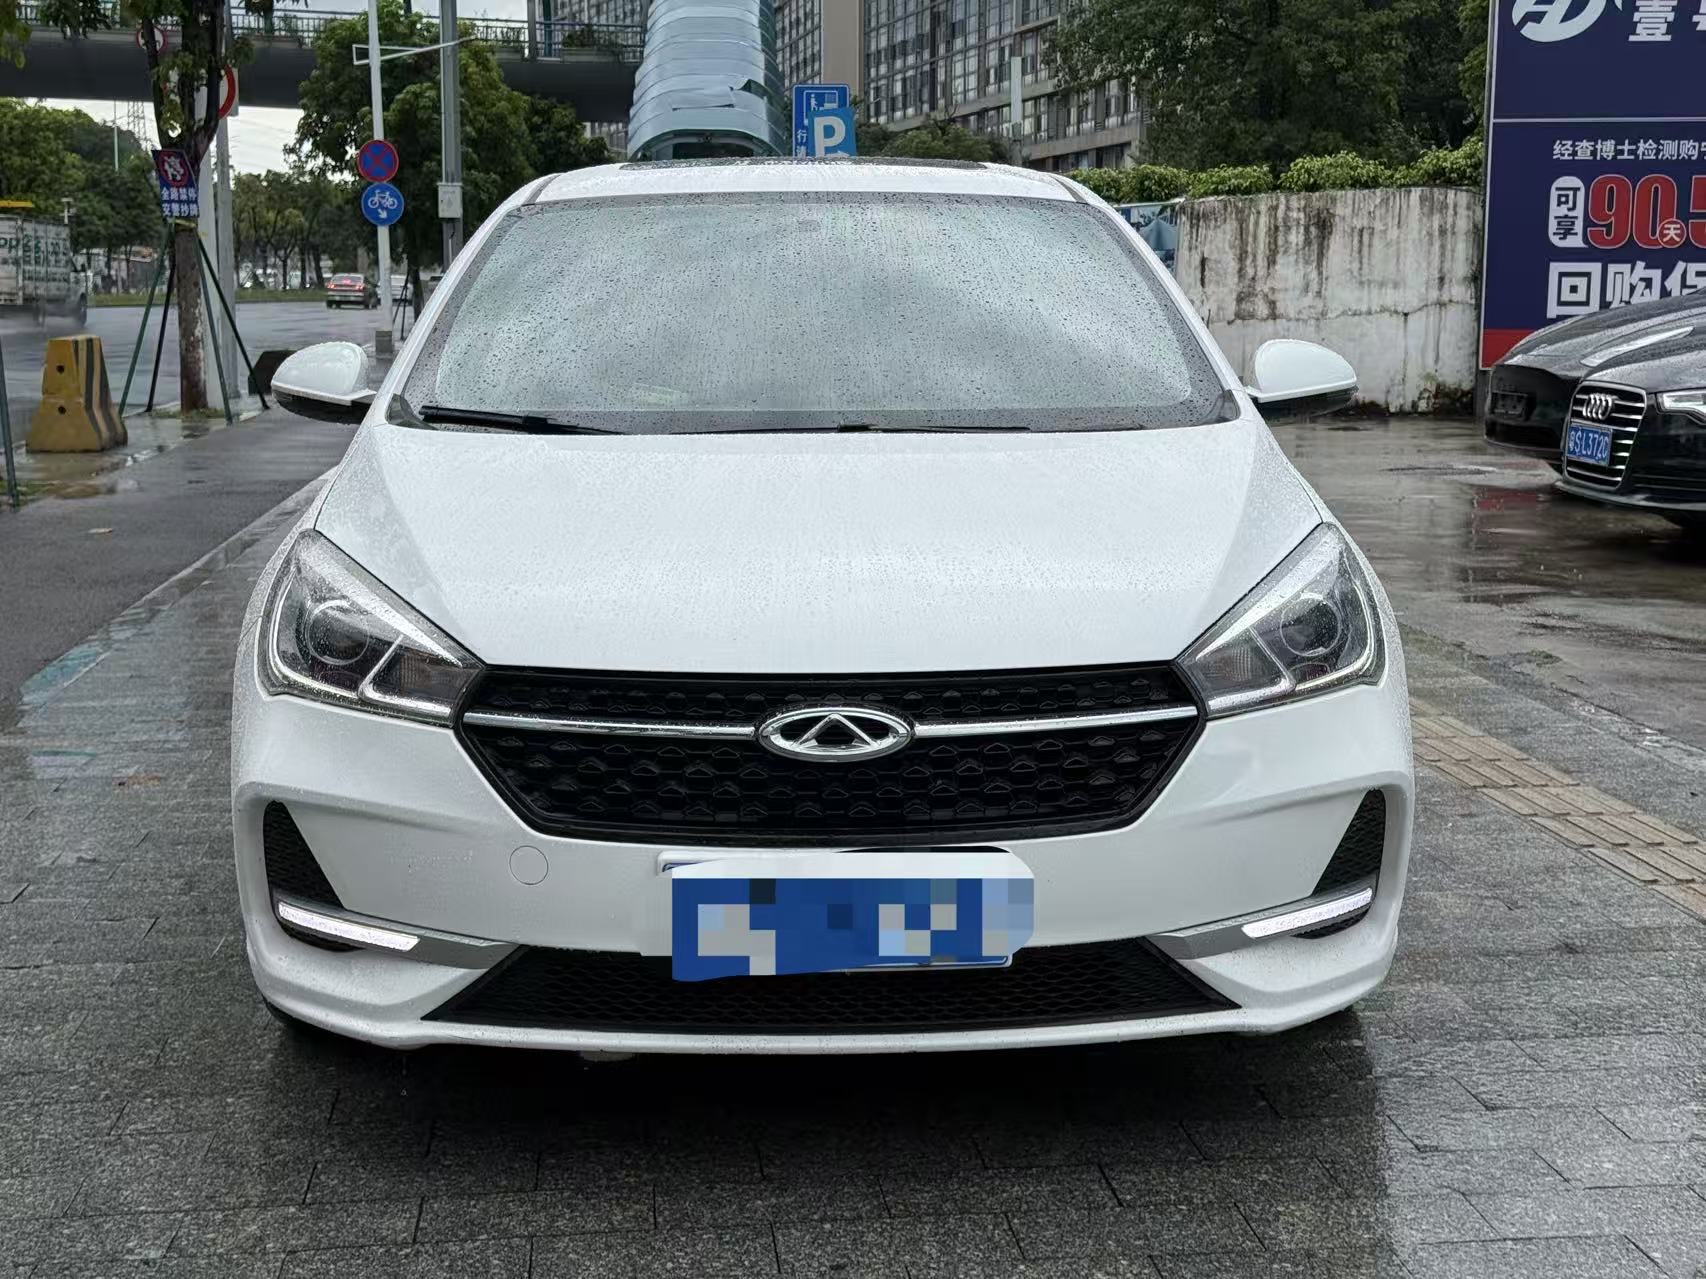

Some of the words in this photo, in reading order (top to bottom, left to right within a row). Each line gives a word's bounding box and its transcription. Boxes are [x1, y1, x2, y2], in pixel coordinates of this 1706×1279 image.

[814, 116, 846, 157] P
[1553, 139, 1706, 160] 经查博士检测购
[1553, 187, 1580, 240] 可享
